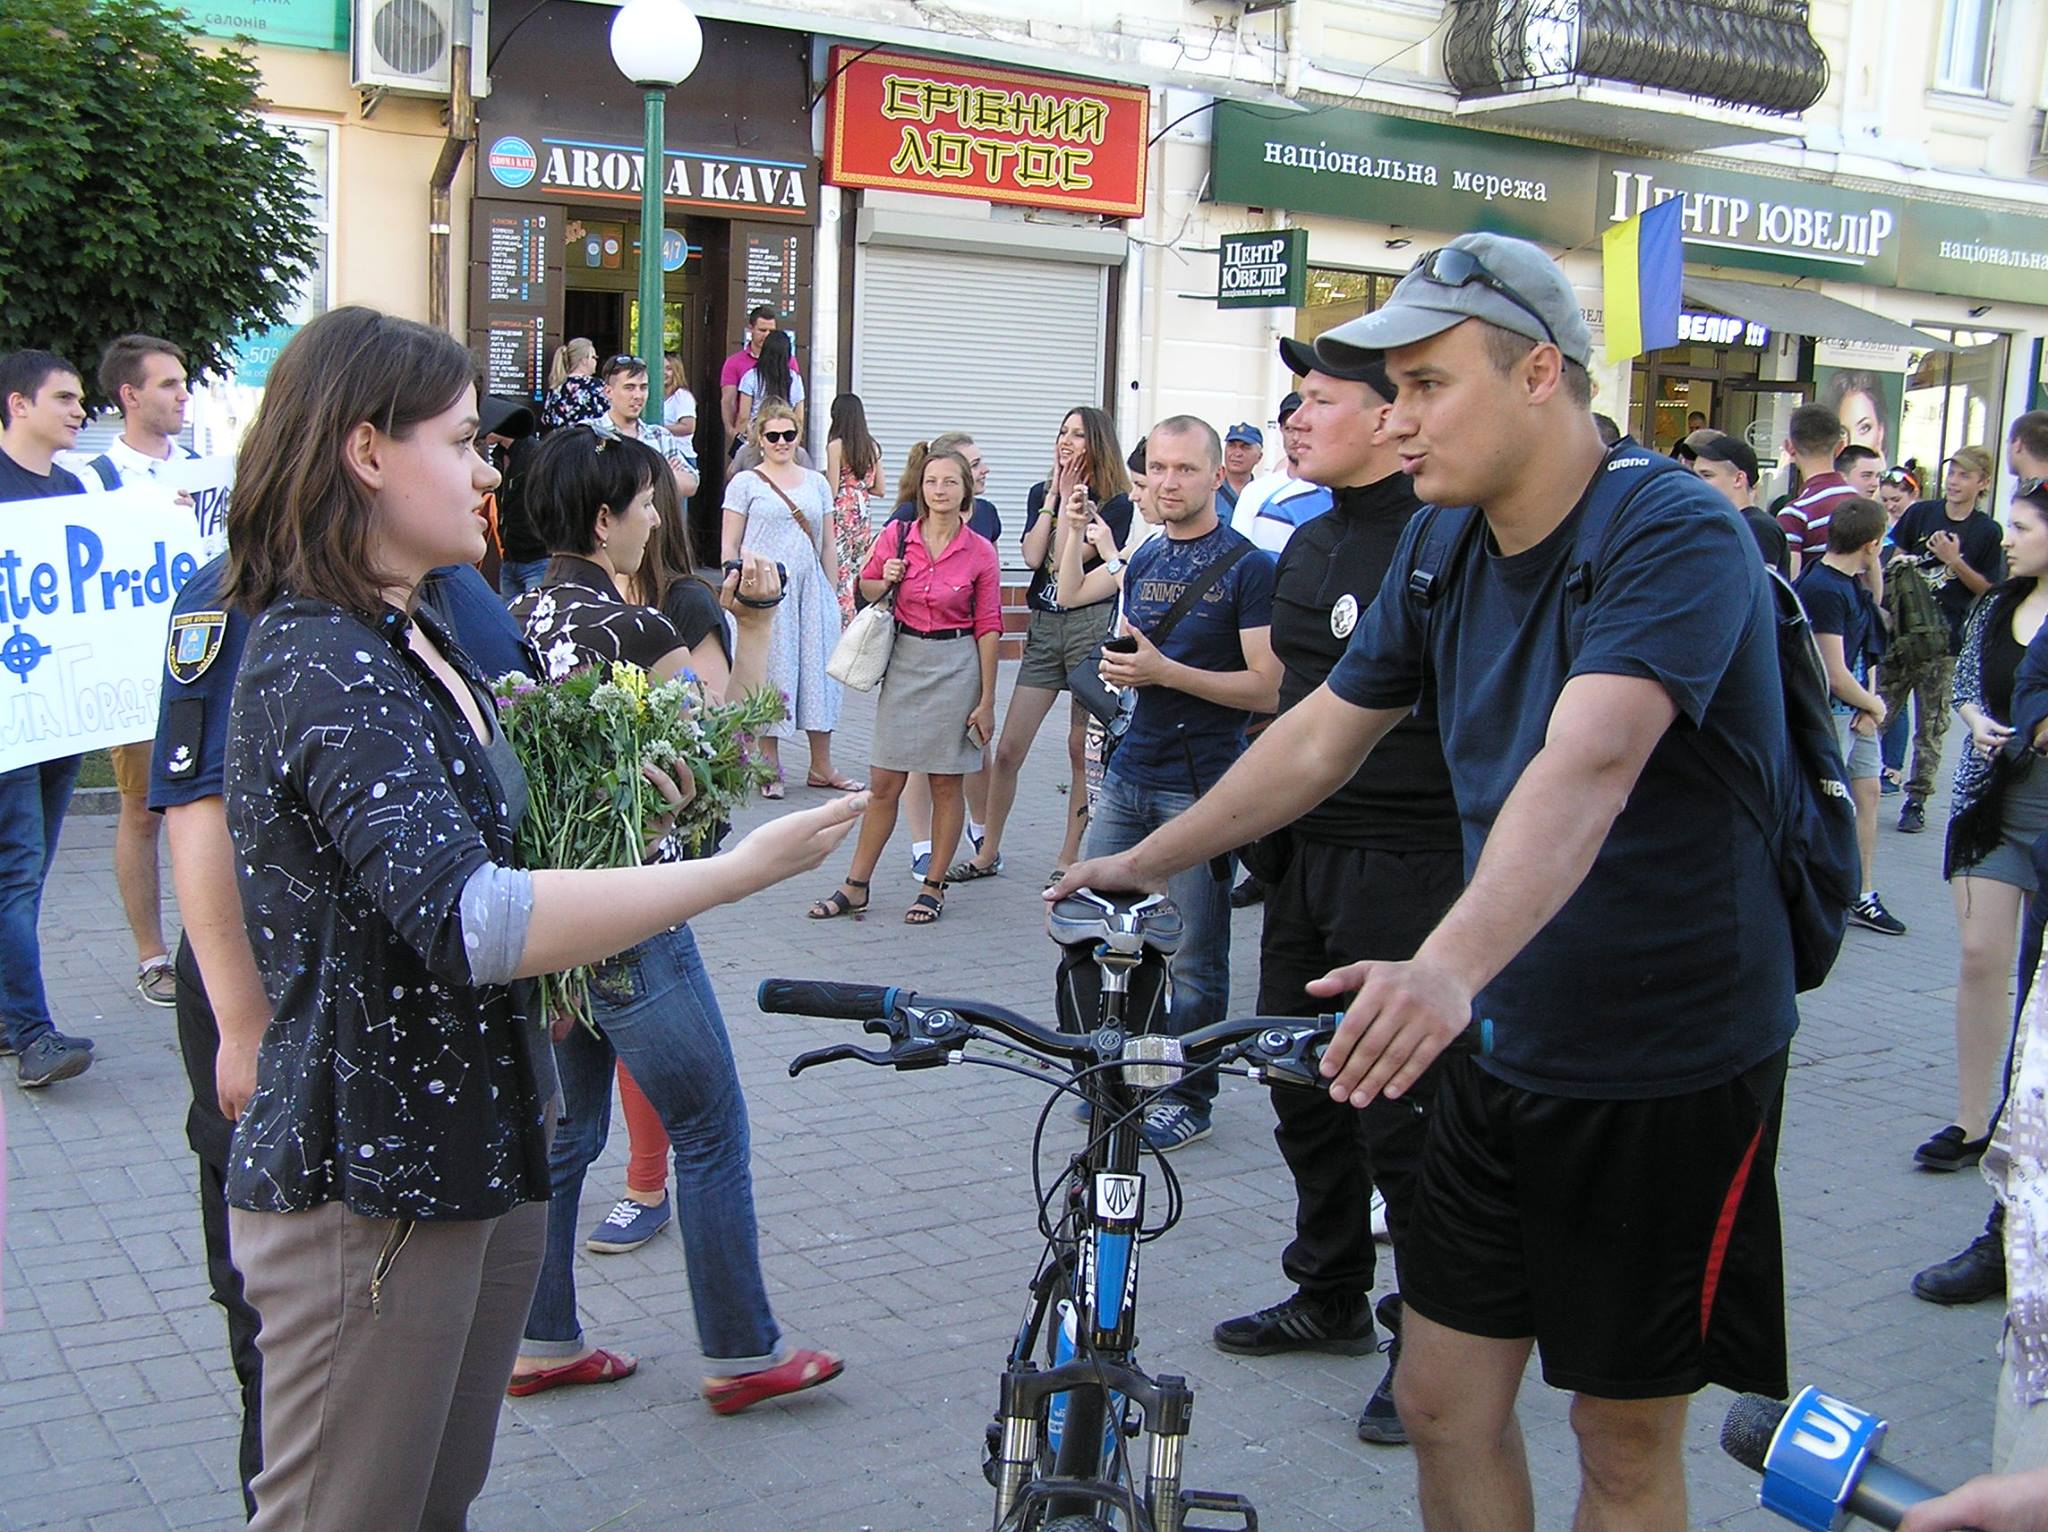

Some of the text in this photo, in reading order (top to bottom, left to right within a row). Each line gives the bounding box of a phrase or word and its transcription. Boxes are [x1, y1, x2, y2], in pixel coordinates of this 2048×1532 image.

[205, 13, 267, 29] салонів
[883, 76, 1107, 142] СРІБНИЙ
[701, 162, 807, 207] KAVA
[892, 127, 1091, 189] ЛОТОС
[1264, 141, 1548, 202] національна мережа
[1939, 238, 2048, 271] національна
[65, 525, 198, 614] Pride
[1085, 1223, 1096, 1308] TREK
[1791, 1394, 1871, 1460] UA
